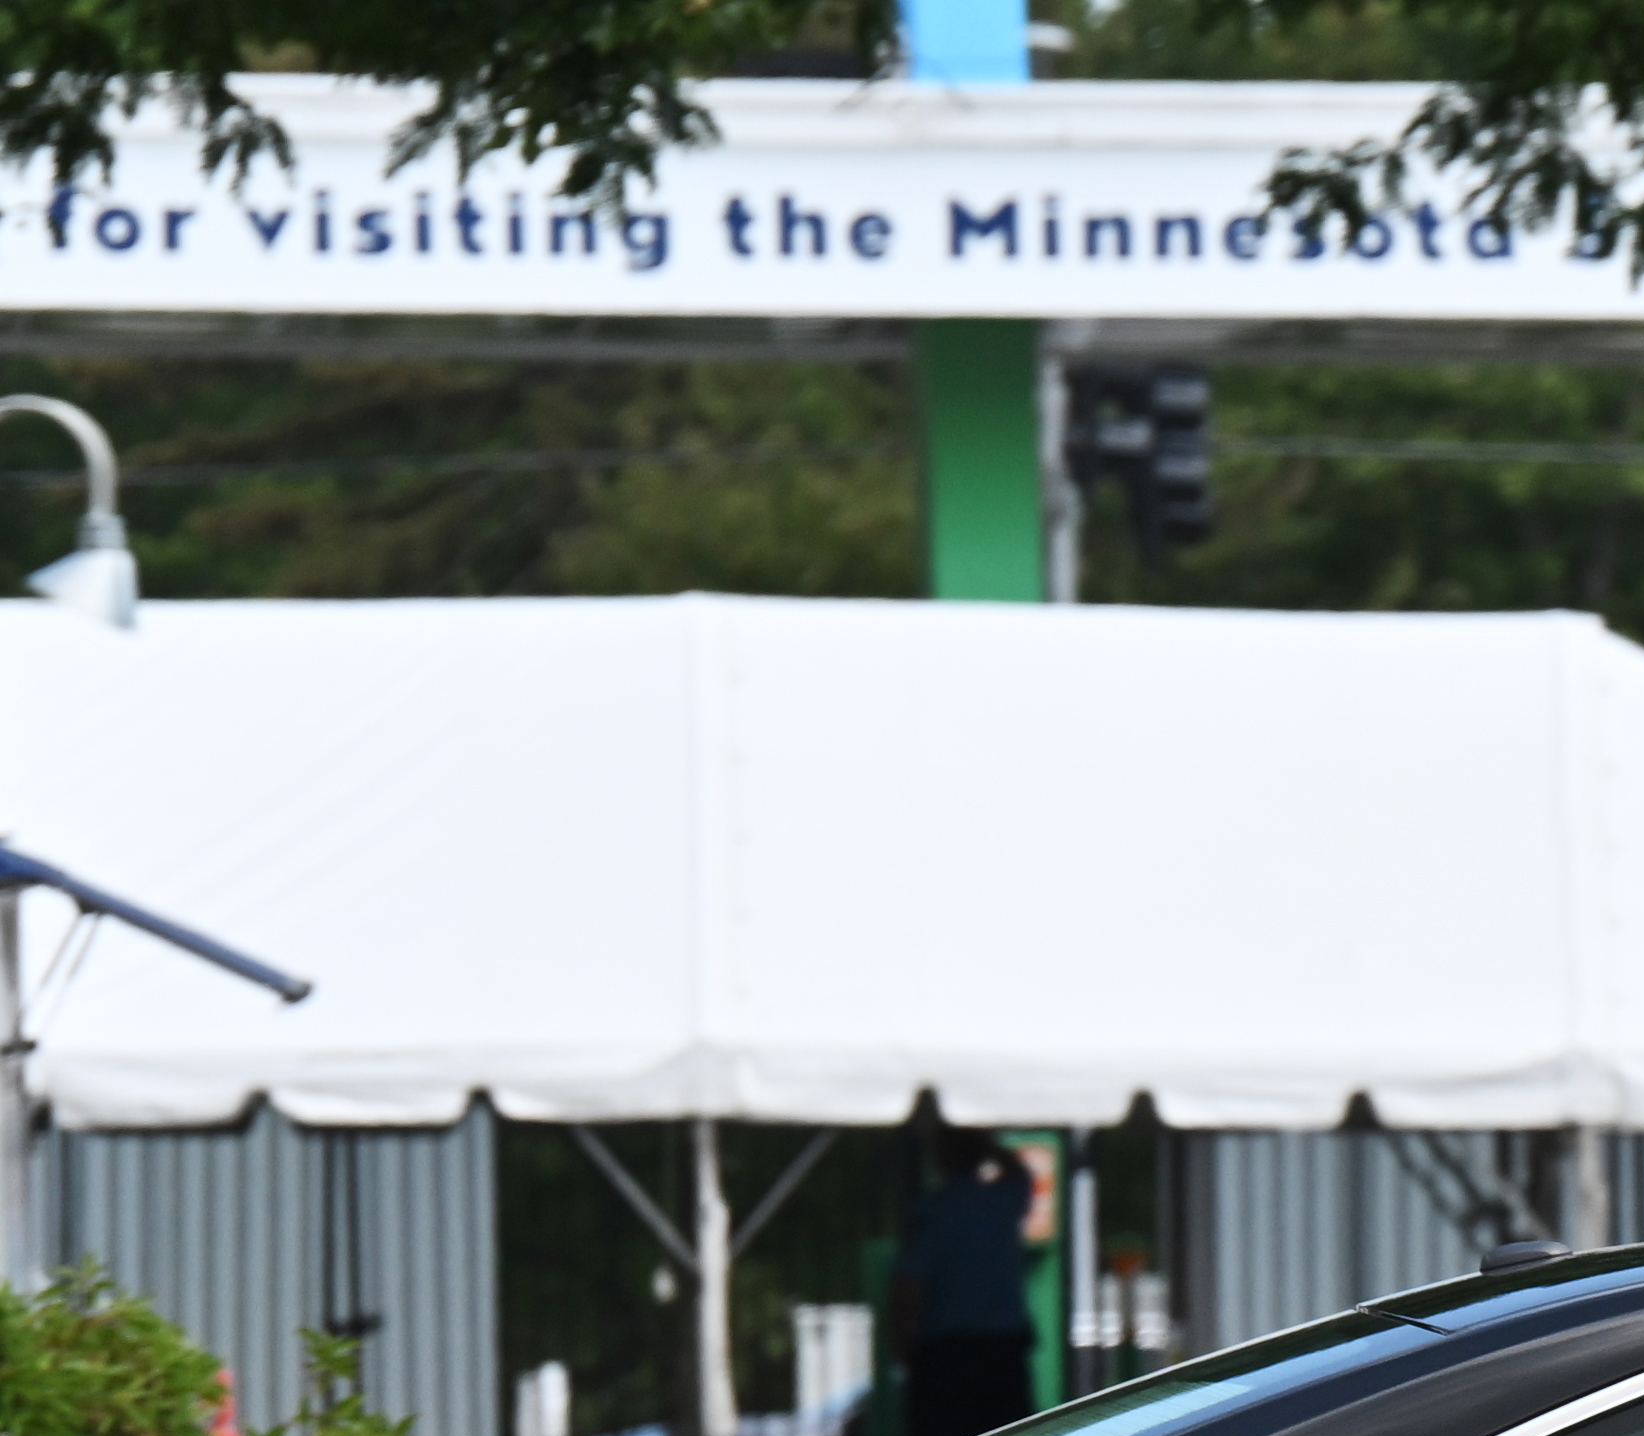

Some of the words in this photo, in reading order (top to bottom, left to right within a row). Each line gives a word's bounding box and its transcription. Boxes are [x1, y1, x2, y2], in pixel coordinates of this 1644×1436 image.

[46, 187, 196, 249] for
[247, 190, 669, 270] visiting
[725, 195, 893, 257] the
[948, 194, 1512, 260] Minnesota
